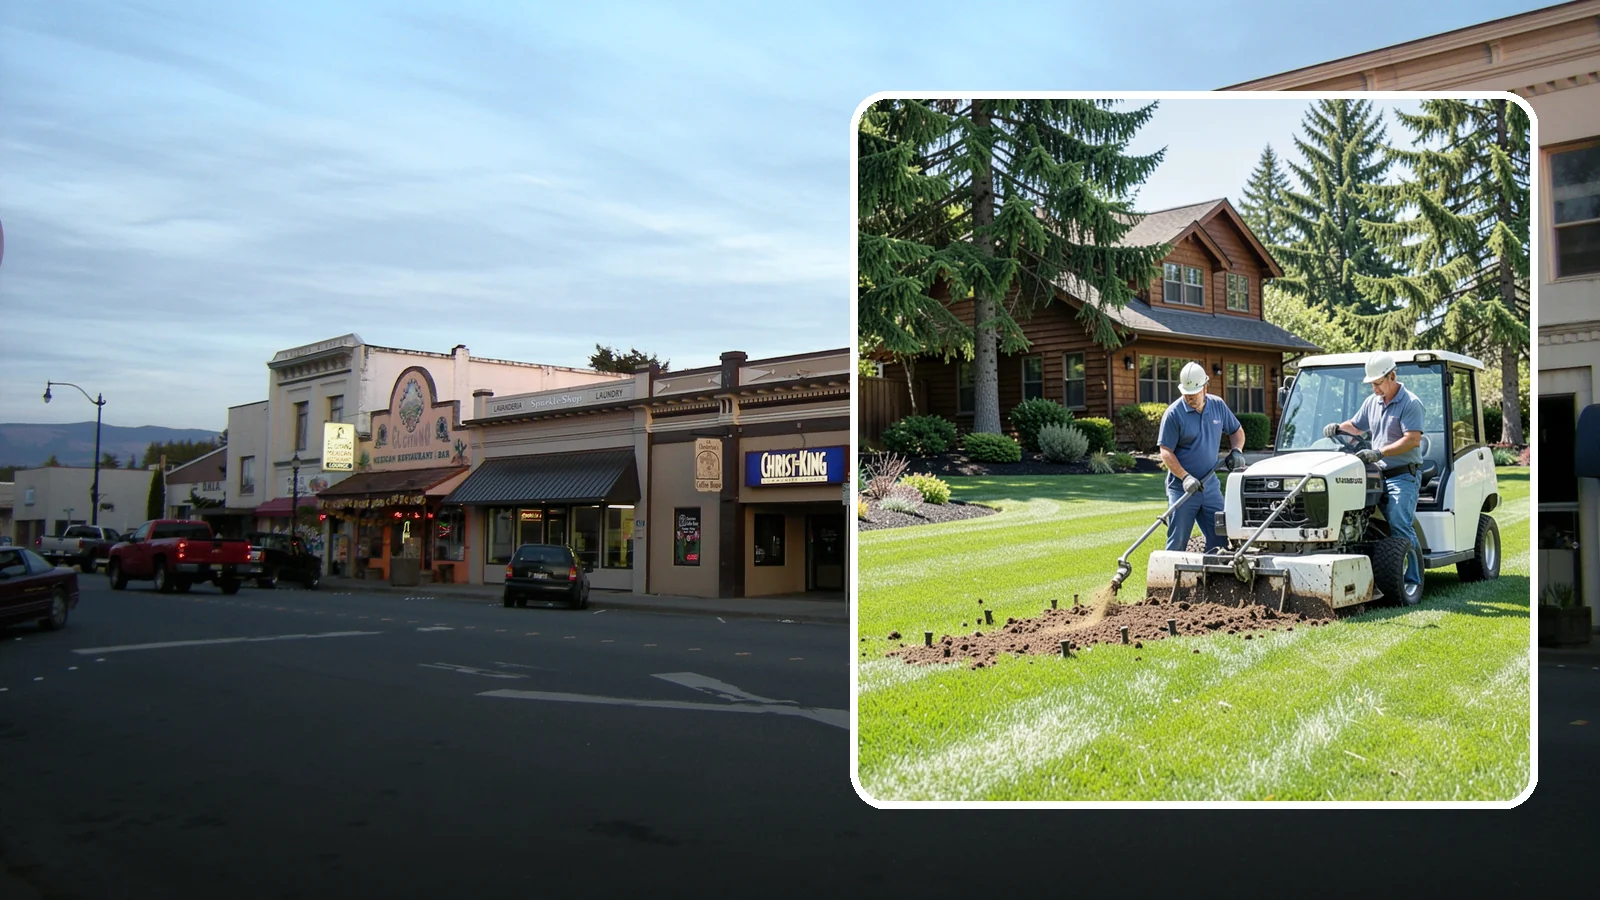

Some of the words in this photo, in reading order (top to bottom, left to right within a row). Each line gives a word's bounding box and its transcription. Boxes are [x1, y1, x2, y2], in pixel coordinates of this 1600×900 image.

[493, 402, 522, 413] LAVANDERIA
[530, 398, 560, 409] Sparkle
[562, 394, 583, 405] Shop
[595, 389, 623, 400] LAUNDRY
[373, 455, 396, 464] MEXICAN
[397, 451, 433, 462] RESTAURANT
[438, 450, 450, 459] BAR
[760, 452, 798, 478] CHRIST
[799, 450, 827, 476] KING
[696, 480, 709, 489] Coffee
